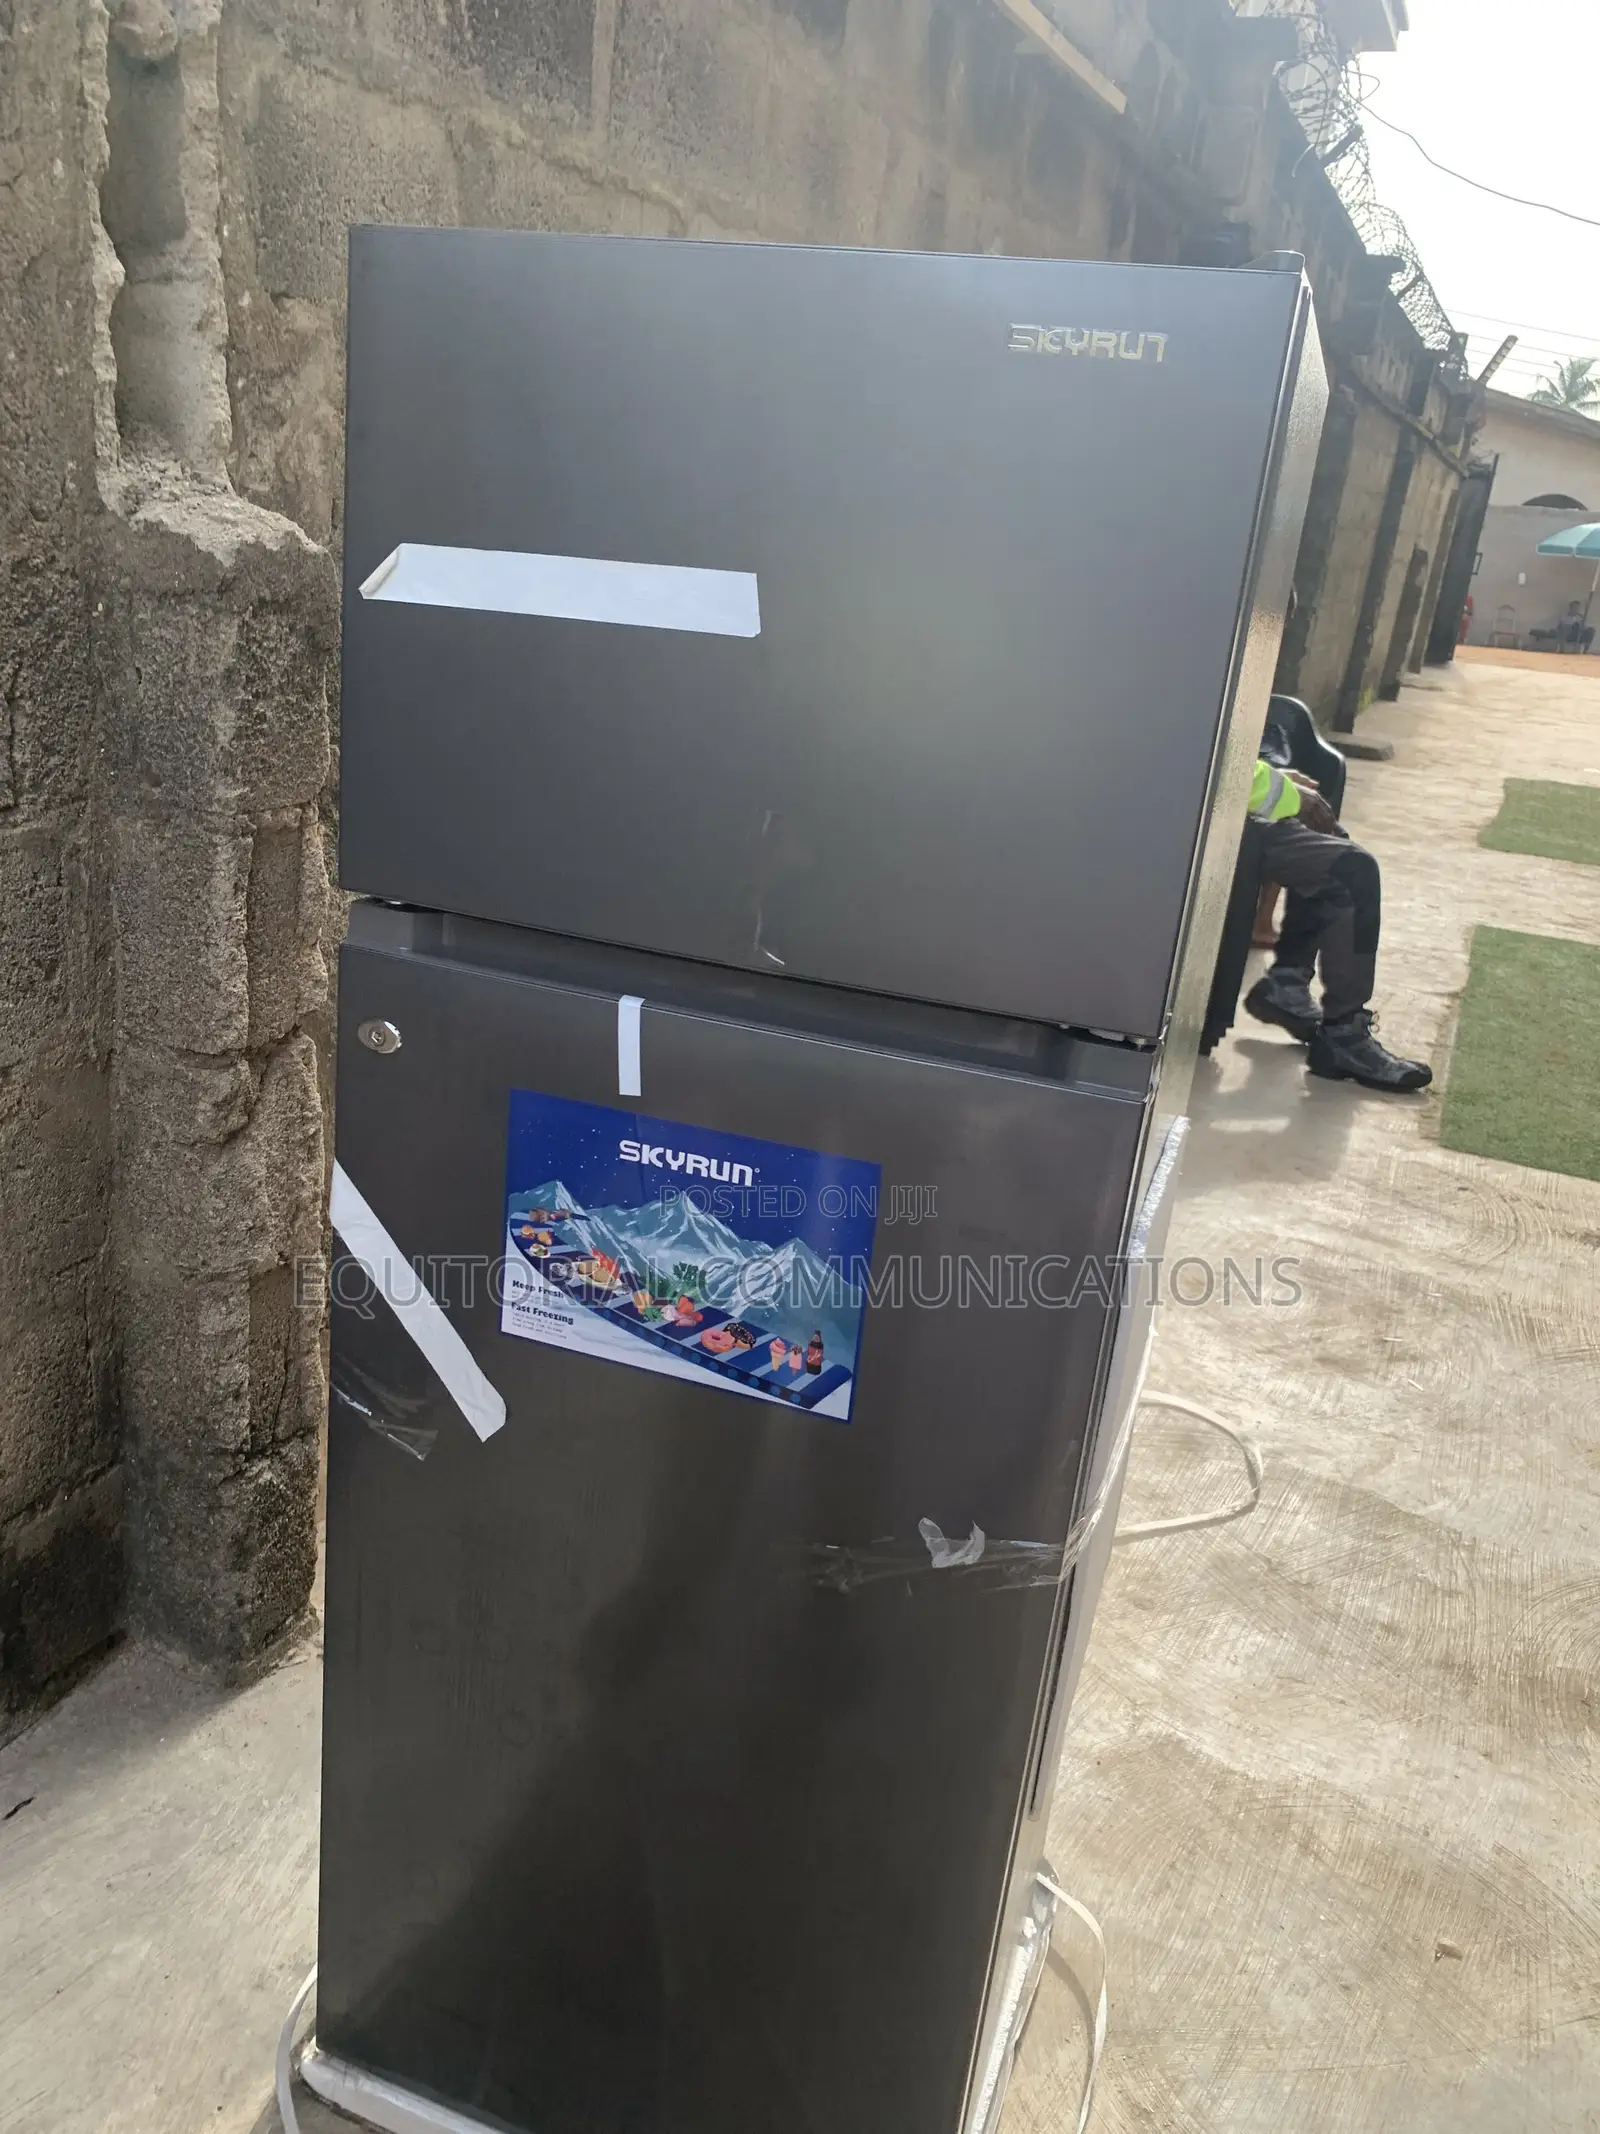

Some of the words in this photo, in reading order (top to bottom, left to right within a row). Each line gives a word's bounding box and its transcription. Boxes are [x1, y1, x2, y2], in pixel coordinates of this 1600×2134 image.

[1007, 323, 1169, 362] SKYRUN
[619, 1140, 754, 1186] SKYRUN
[512, 1280, 536, 1292] Keep
[538, 1286, 564, 1299] Fresh
[511, 1302, 531, 1314] Fast
[533, 1307, 575, 1326] Freezing
